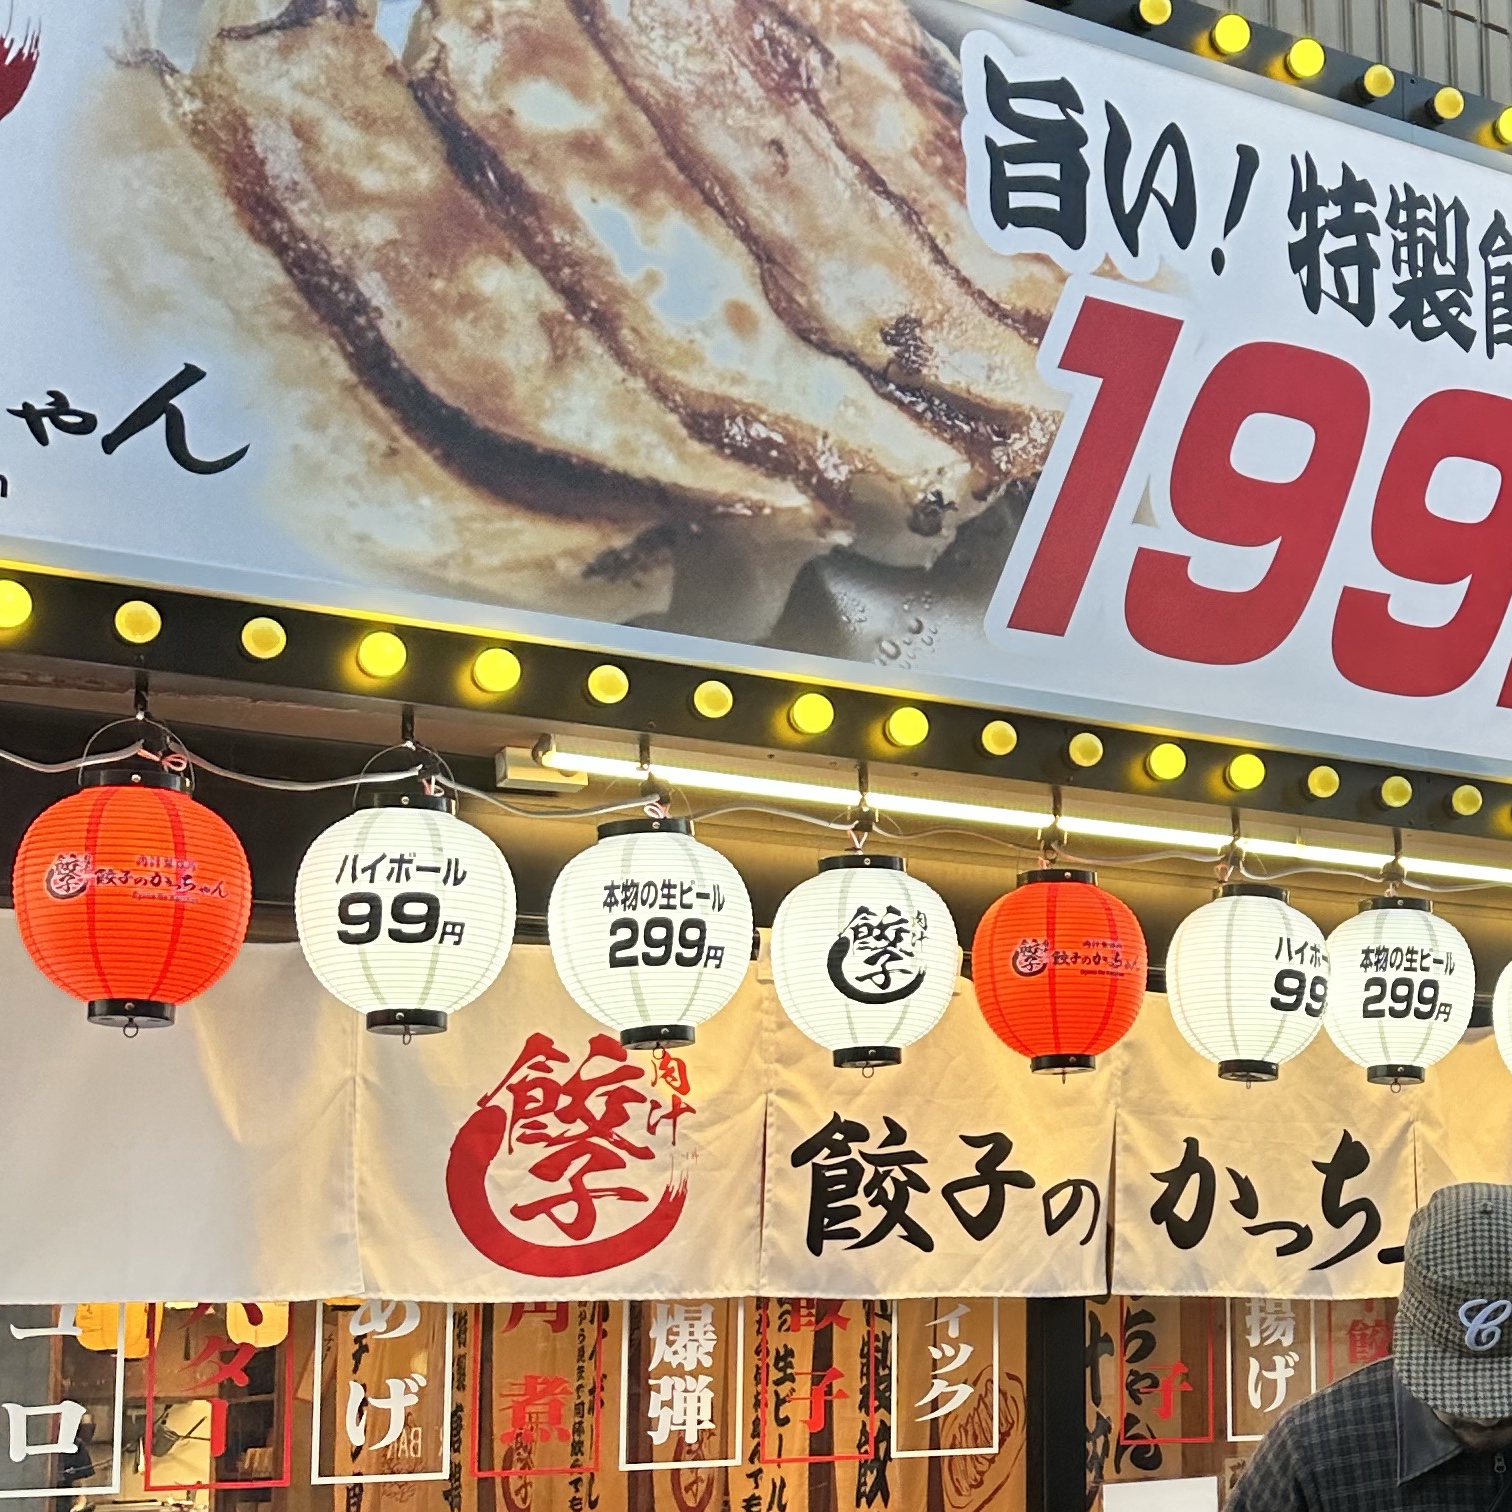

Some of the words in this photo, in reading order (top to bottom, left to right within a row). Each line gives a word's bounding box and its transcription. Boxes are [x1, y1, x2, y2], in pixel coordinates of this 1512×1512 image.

[336, 853, 467, 889] ハイボール
[602, 878, 725, 914] 本物の生ビール
[336, 892, 465, 947] 99円
[607, 916, 725, 970] 299円
[1275, 936, 1331, 970] ハイボー
[1360, 945, 1456, 976] 本物の生ビール
[1362, 976, 1452, 1022] 299円
[648, 1303, 718, 1446] 爆弾
